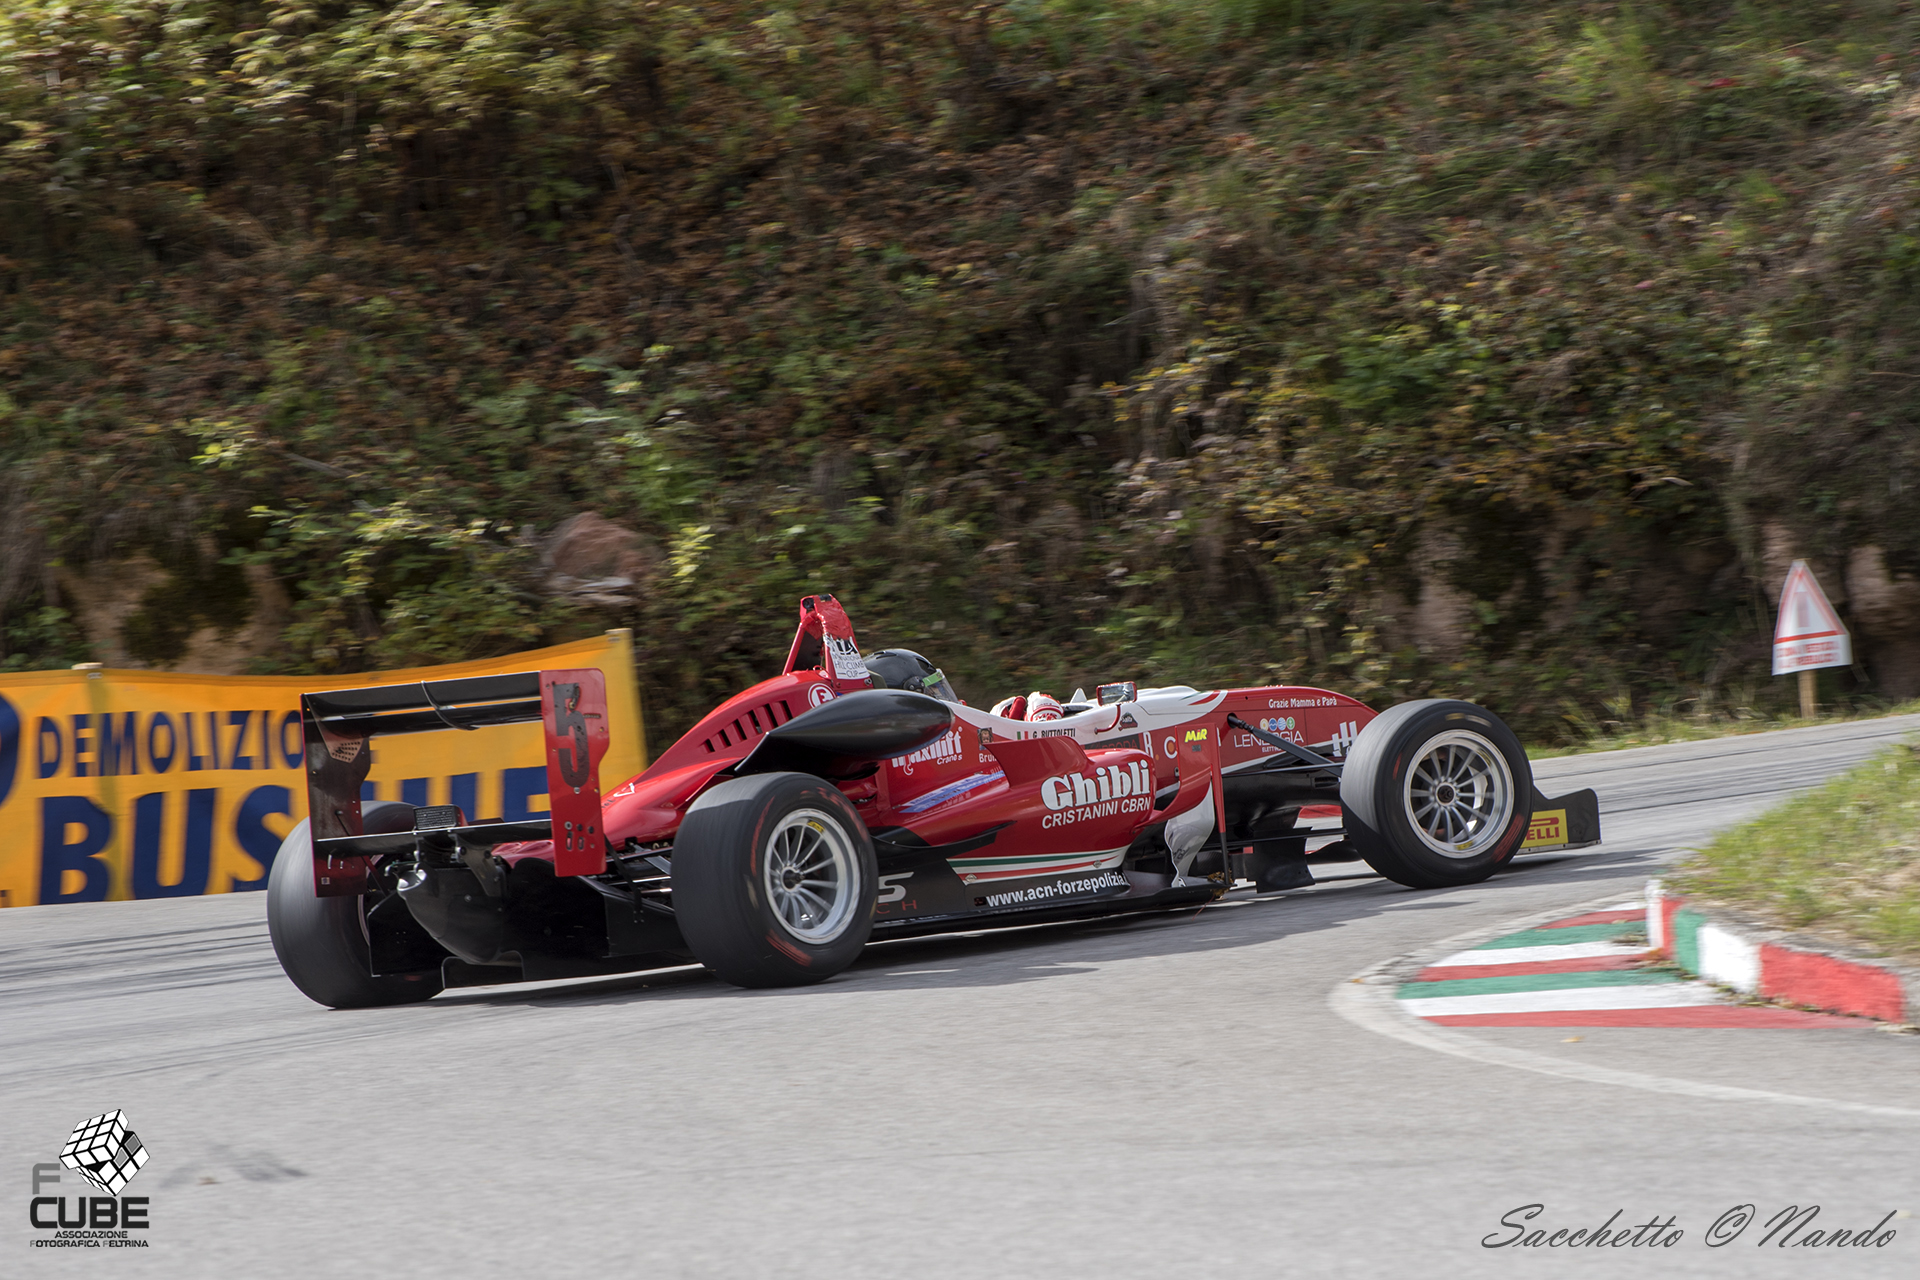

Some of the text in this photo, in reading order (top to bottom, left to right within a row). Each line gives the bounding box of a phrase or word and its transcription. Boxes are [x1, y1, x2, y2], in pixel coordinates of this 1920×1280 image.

[845, 669, 858, 678] CUP
[1268, 699, 1288, 709] Grazie
[1290, 698, 1315, 708] Mamma
[1316, 699, 1321, 707] e
[34, 708, 306, 780] DEMOLIZIO
[1041, 759, 1151, 811] Ghibli
[1041, 796, 1151, 830] CRISTANINI CBRN
